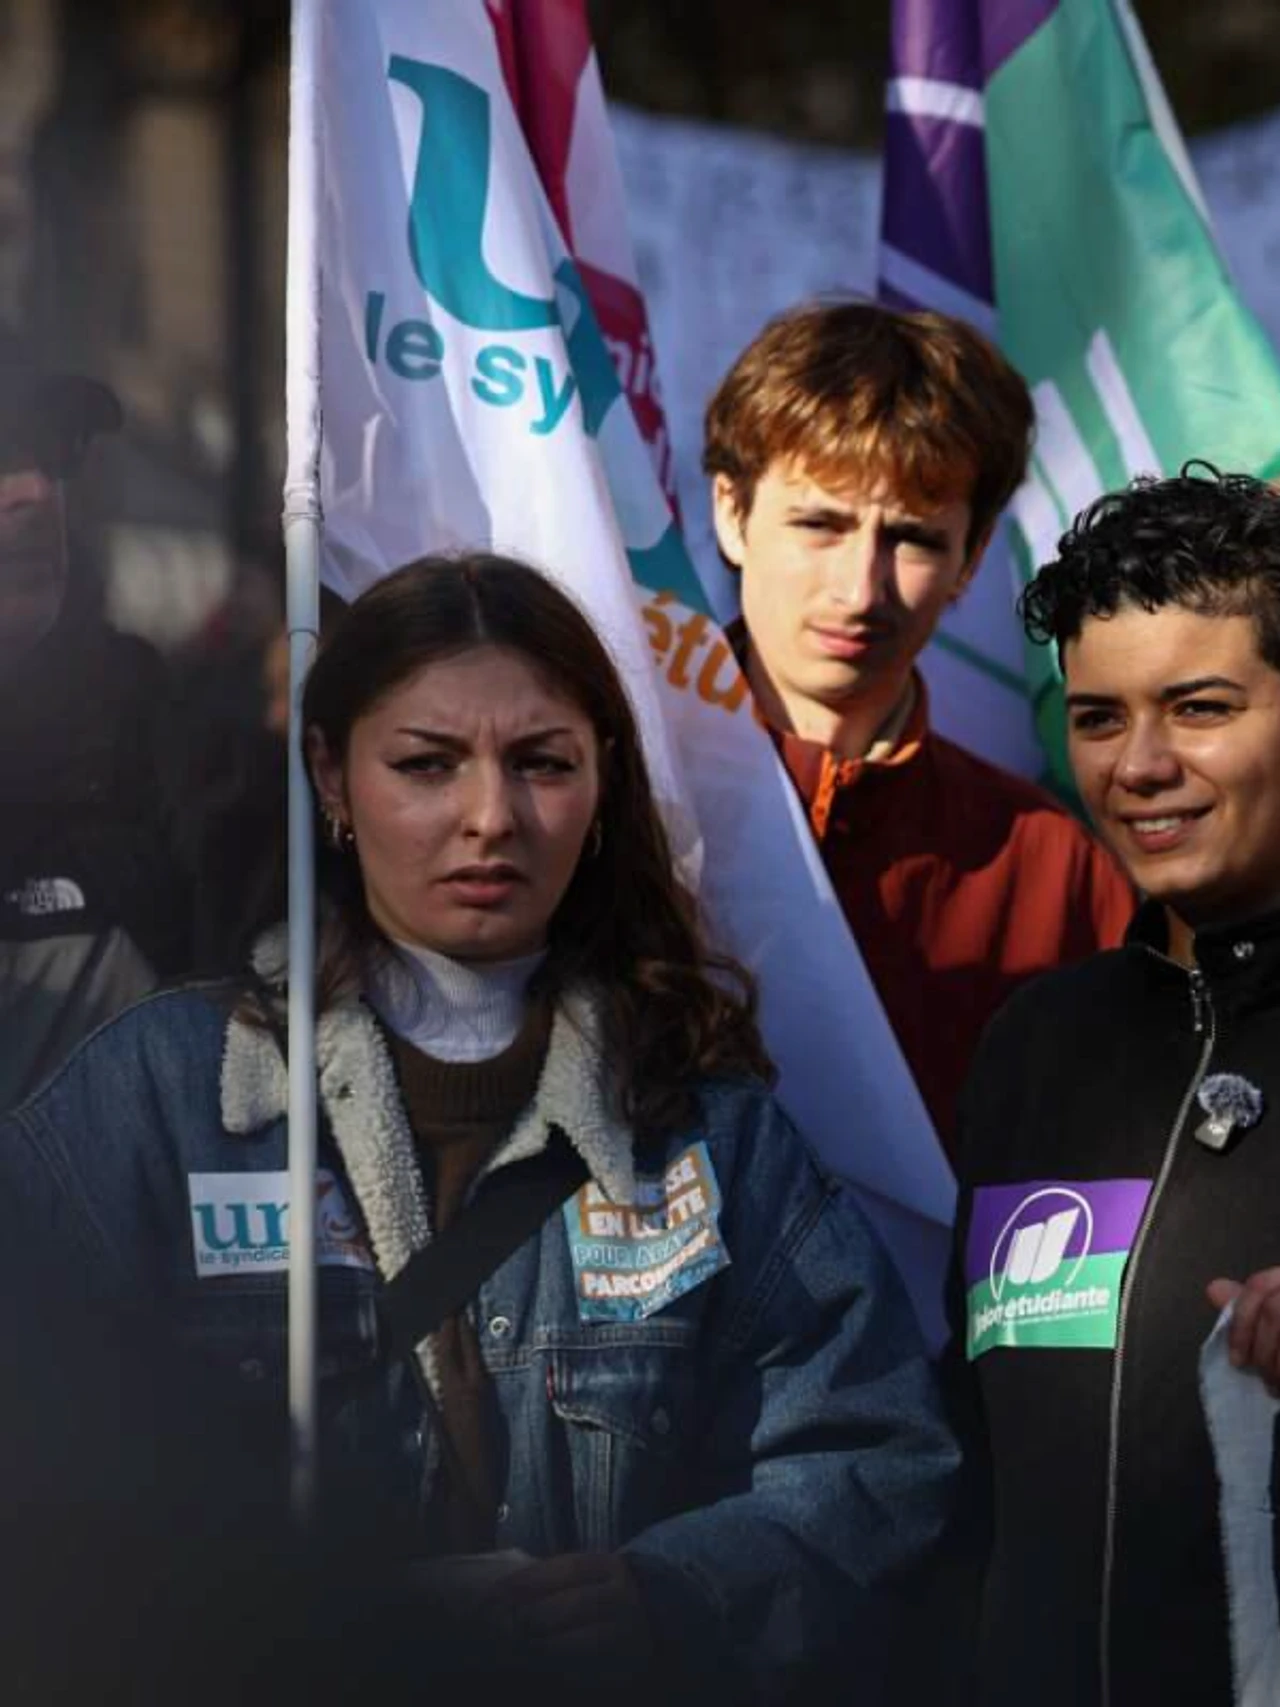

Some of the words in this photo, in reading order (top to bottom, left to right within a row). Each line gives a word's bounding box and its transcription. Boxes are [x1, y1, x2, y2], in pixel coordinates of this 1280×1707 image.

[364, 291, 443, 381] le
[470, 344, 579, 436] sy
[642, 590, 760, 722] étu
[222, 1247, 290, 1266] syndica
[588, 1211, 624, 1237] EN
